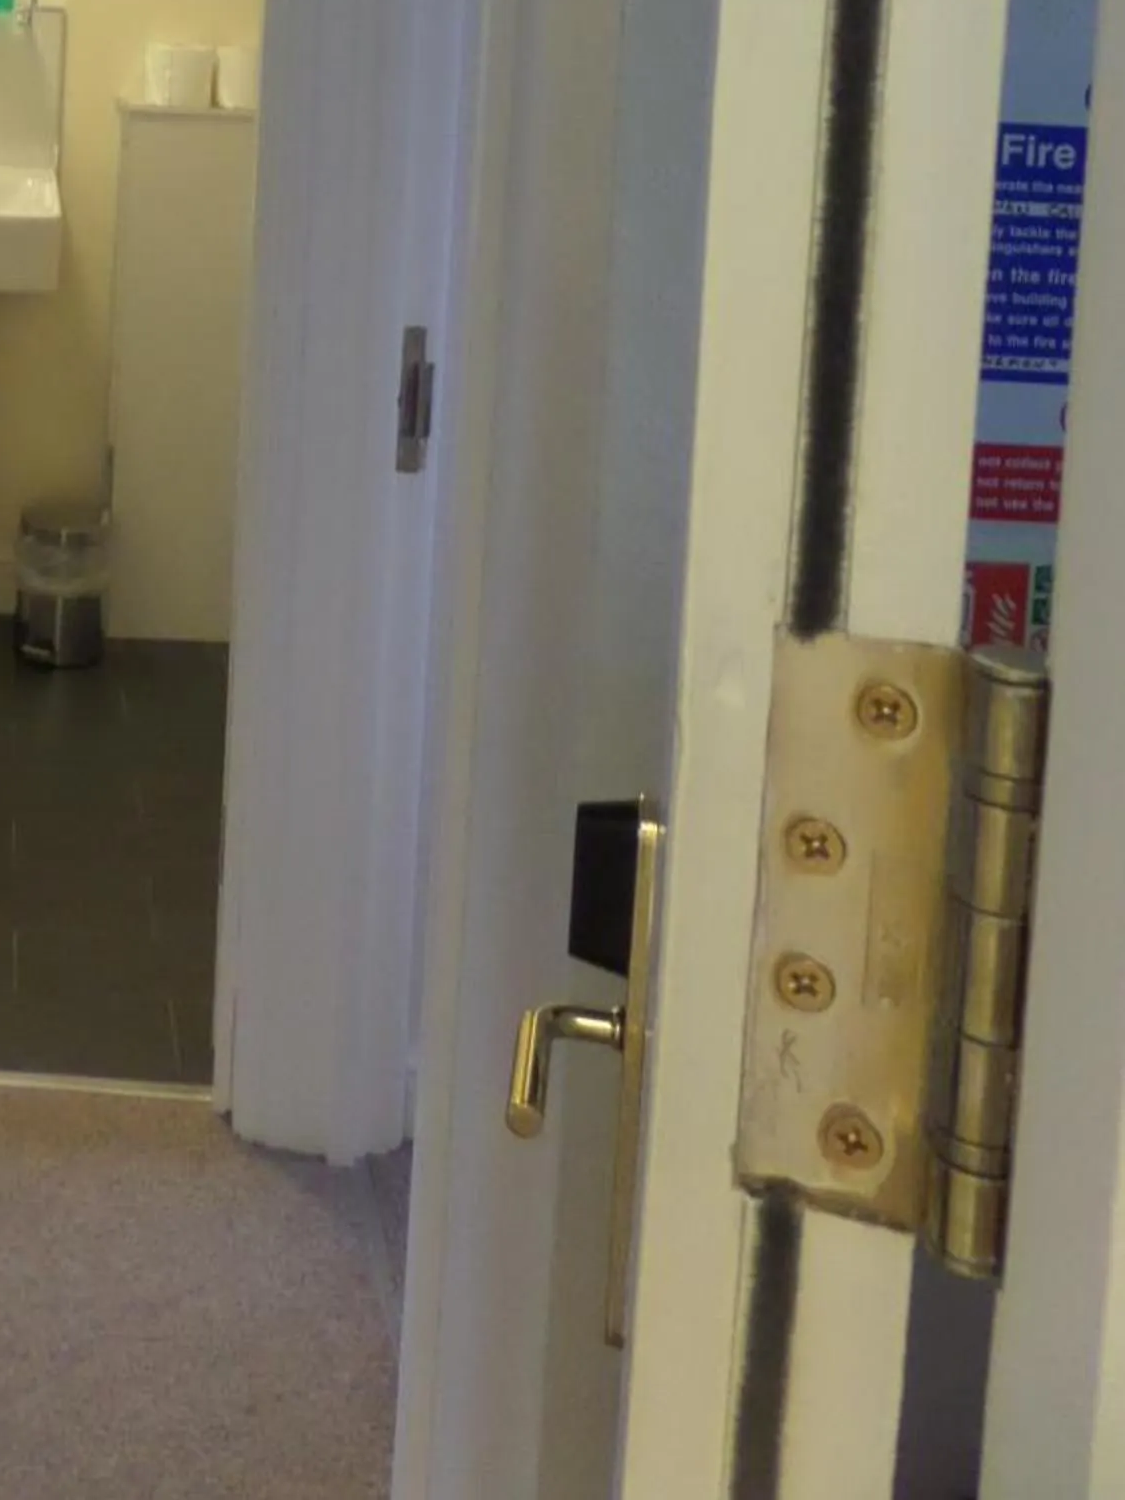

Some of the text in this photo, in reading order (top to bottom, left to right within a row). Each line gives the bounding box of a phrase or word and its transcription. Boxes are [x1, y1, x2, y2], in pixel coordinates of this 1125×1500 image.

[1001, 133, 1077, 171] Fire
[1011, 266, 1040, 284] the
[1012, 292, 1067, 311] building
[1007, 315, 1038, 326] sure
[1007, 335, 1029, 348] the
[1034, 336, 1056, 350] fire
